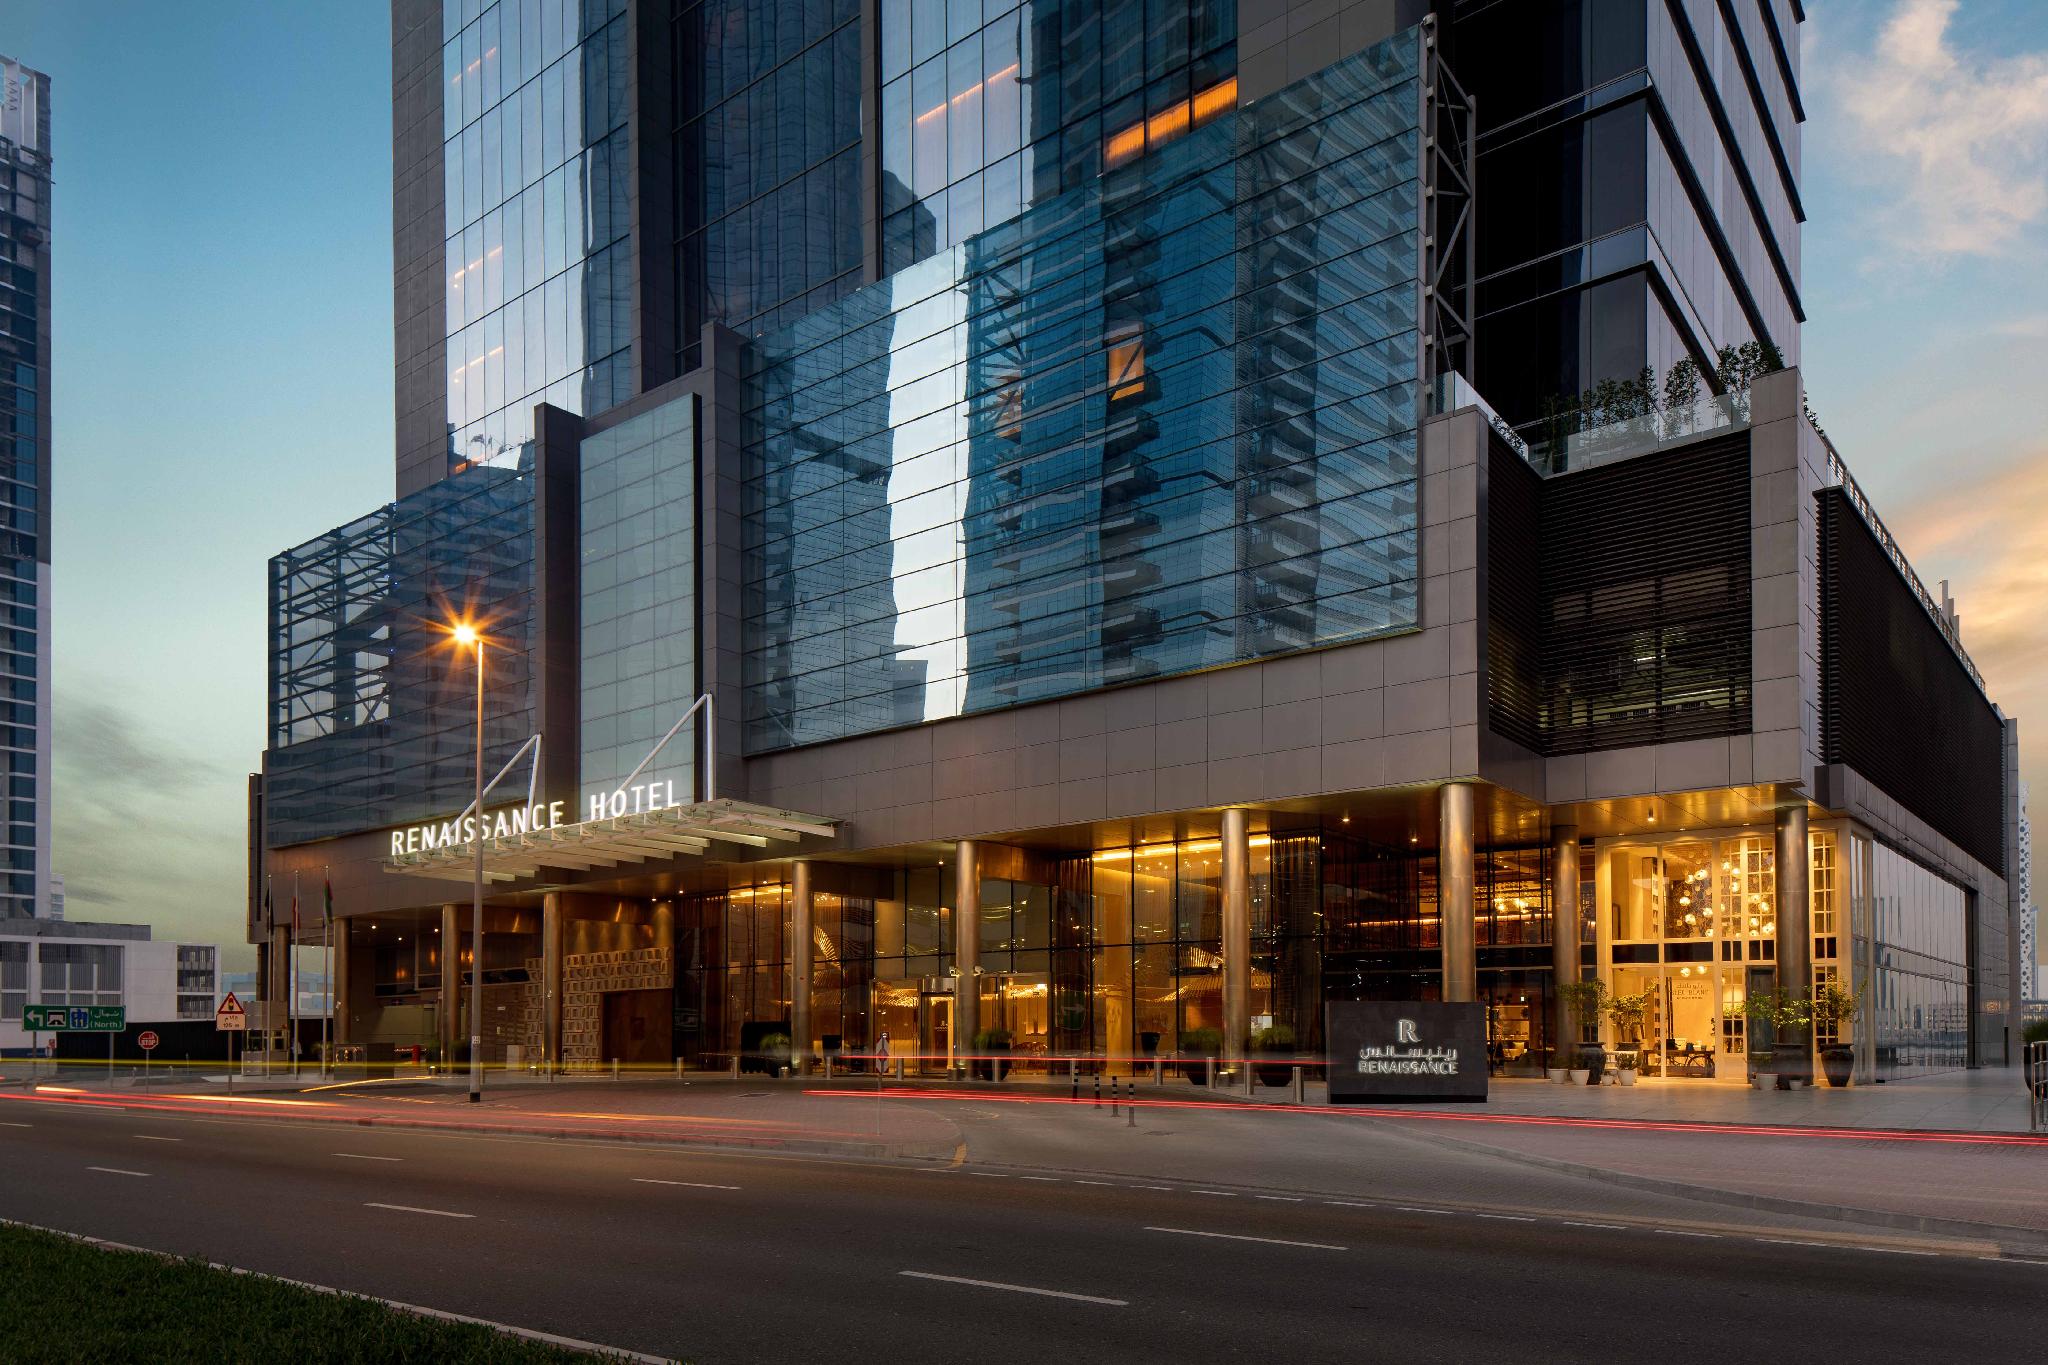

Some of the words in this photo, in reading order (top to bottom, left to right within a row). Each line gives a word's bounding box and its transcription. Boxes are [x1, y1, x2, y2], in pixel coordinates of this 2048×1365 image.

[391, 801, 564, 856] RENAISSANCE
[590, 780, 680, 820] HOTEL
[1398, 1018, 1422, 1043] R
[1358, 1061, 1459, 1074] RENAISSANCE
